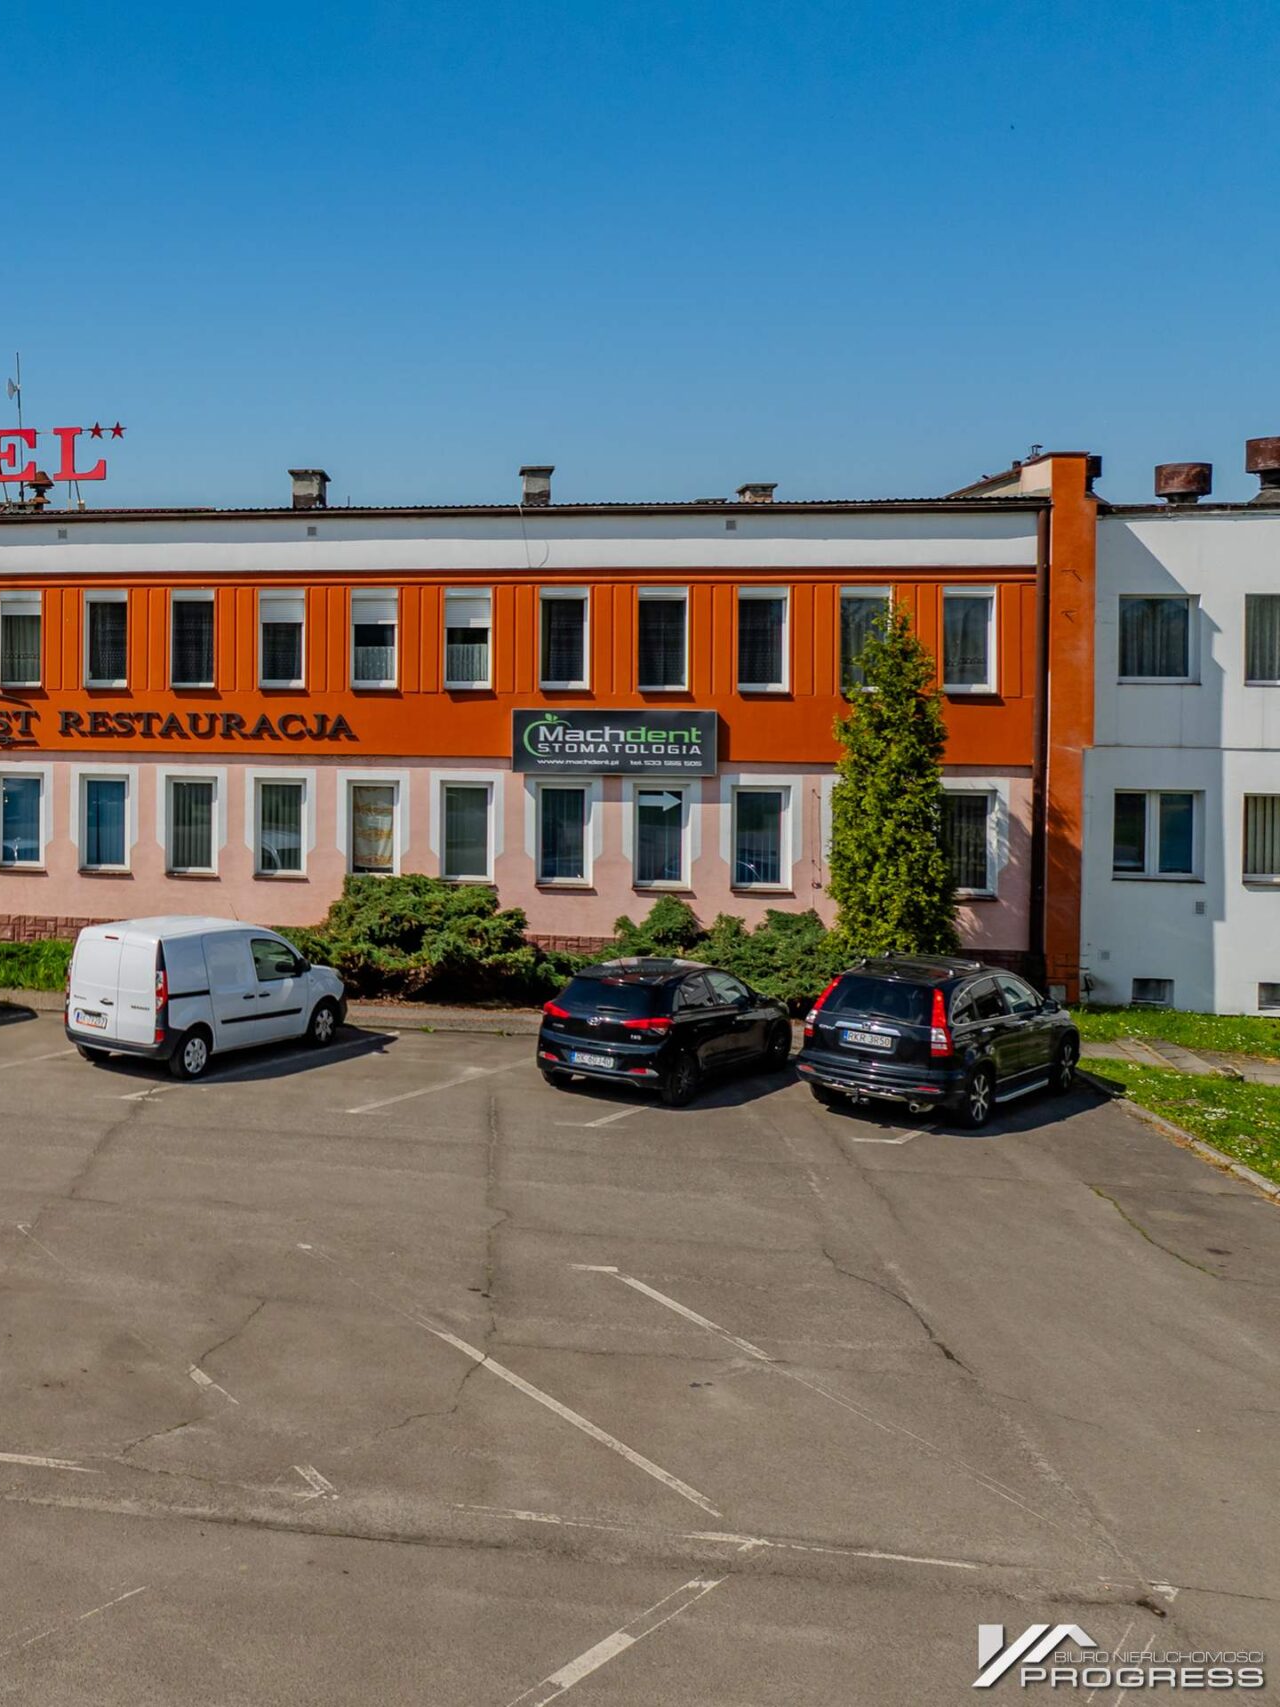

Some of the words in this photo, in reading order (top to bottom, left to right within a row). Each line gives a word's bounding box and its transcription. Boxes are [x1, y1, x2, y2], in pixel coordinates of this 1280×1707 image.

[58, 711, 359, 741] RESTAURACJA
[538, 725, 702, 743] Machdent
[537, 743, 702, 755] STOMATOLOGIA
